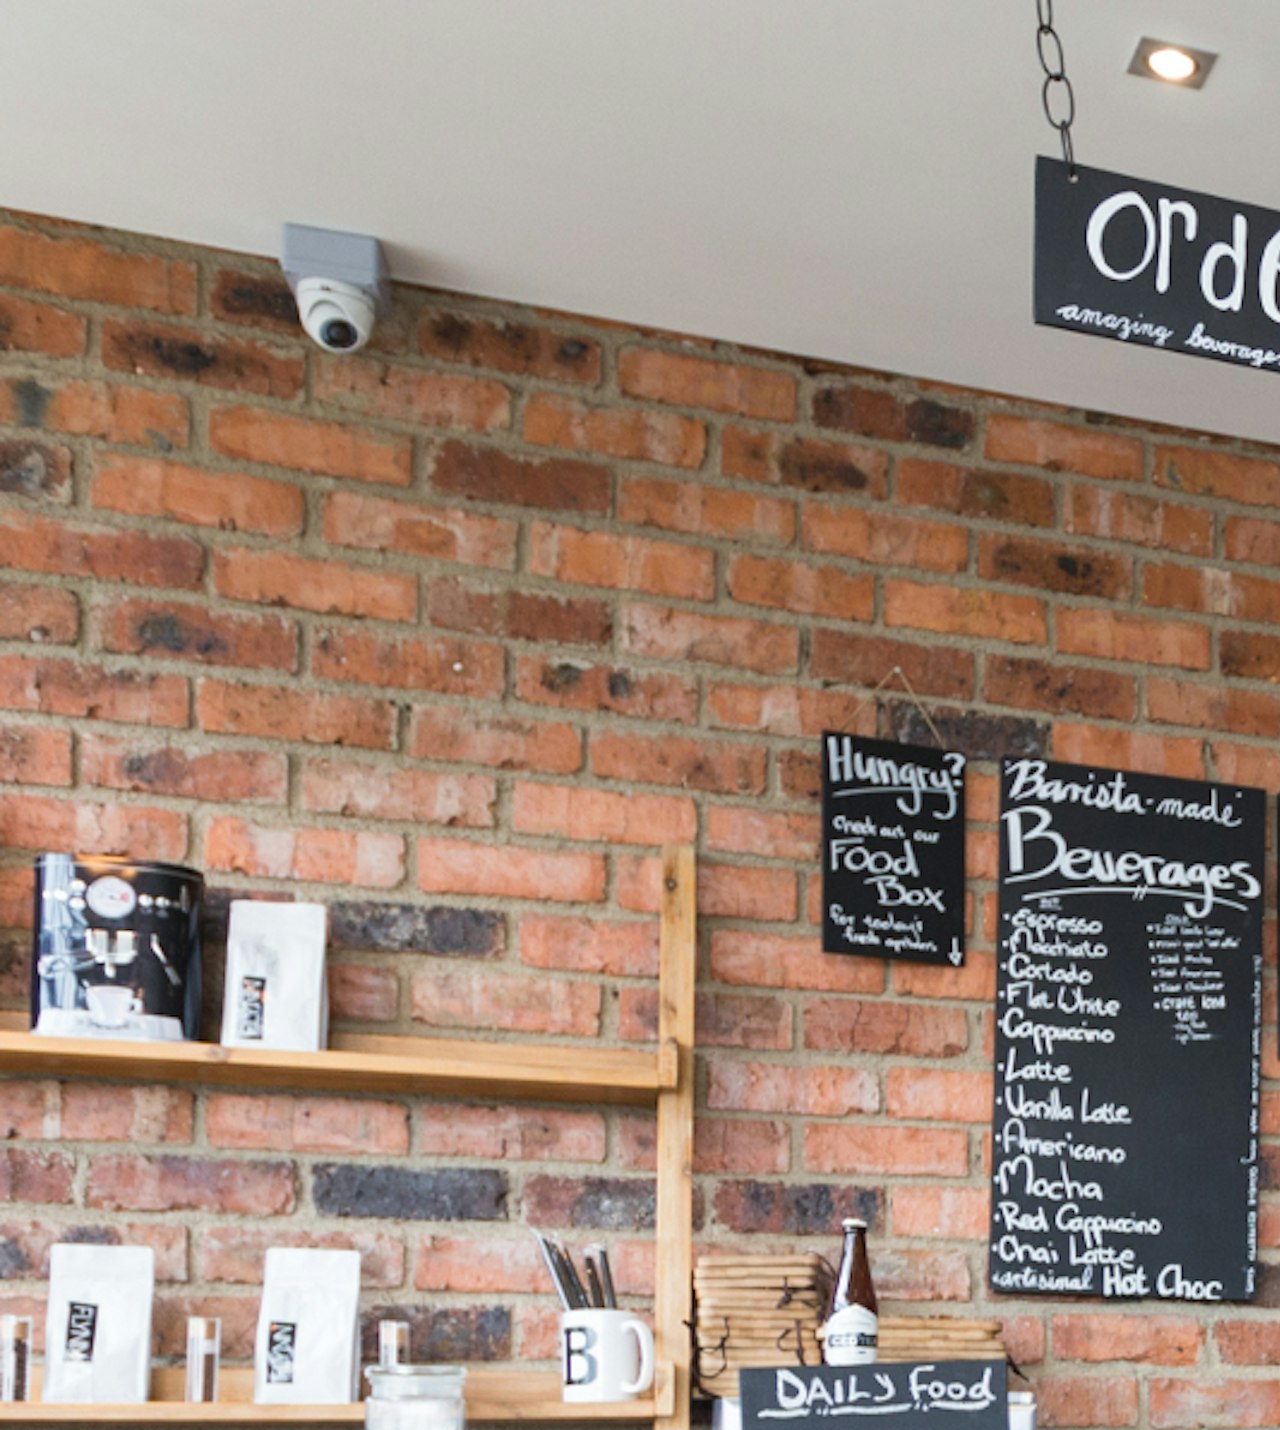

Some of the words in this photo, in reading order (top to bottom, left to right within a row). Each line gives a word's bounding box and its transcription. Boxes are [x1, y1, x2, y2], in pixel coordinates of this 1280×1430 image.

[1055, 303, 1173, 347] amazing
[826, 735, 966, 820] Hungry?
[913, 829, 941, 844] our
[829, 836, 920, 878] Food
[1001, 805, 1261, 918] Beverages
[863, 874, 946, 914] Box
[829, 904, 855, 926] for
[1010, 907, 1103, 943] Espresso
[1009, 926, 1109, 958] Macchiato
[1007, 952, 1094, 985] Cortado
[1006, 980, 1054, 1009] Flat
[1057, 984, 1122, 1017] White
[1001, 1007, 1116, 1055] Cappuccino
[1004, 1047, 1073, 1084] Latte
[1004, 1083, 1074, 1122] Vanilla
[1080, 1086, 1133, 1124] Latte
[1002, 1117, 1127, 1163] Americano
[999, 1154, 1103, 1201] Mocha
[998, 1201, 1049, 1233] Red
[1055, 1202, 1163, 1248] Cappuccino
[998, 1234, 1059, 1265] Chai
[1069, 1234, 1136, 1269] Latte
[1102, 1264, 1150, 1297] Hot
[1156, 1263, 1224, 1300] Choc
[564, 1327, 598, 1385] B
